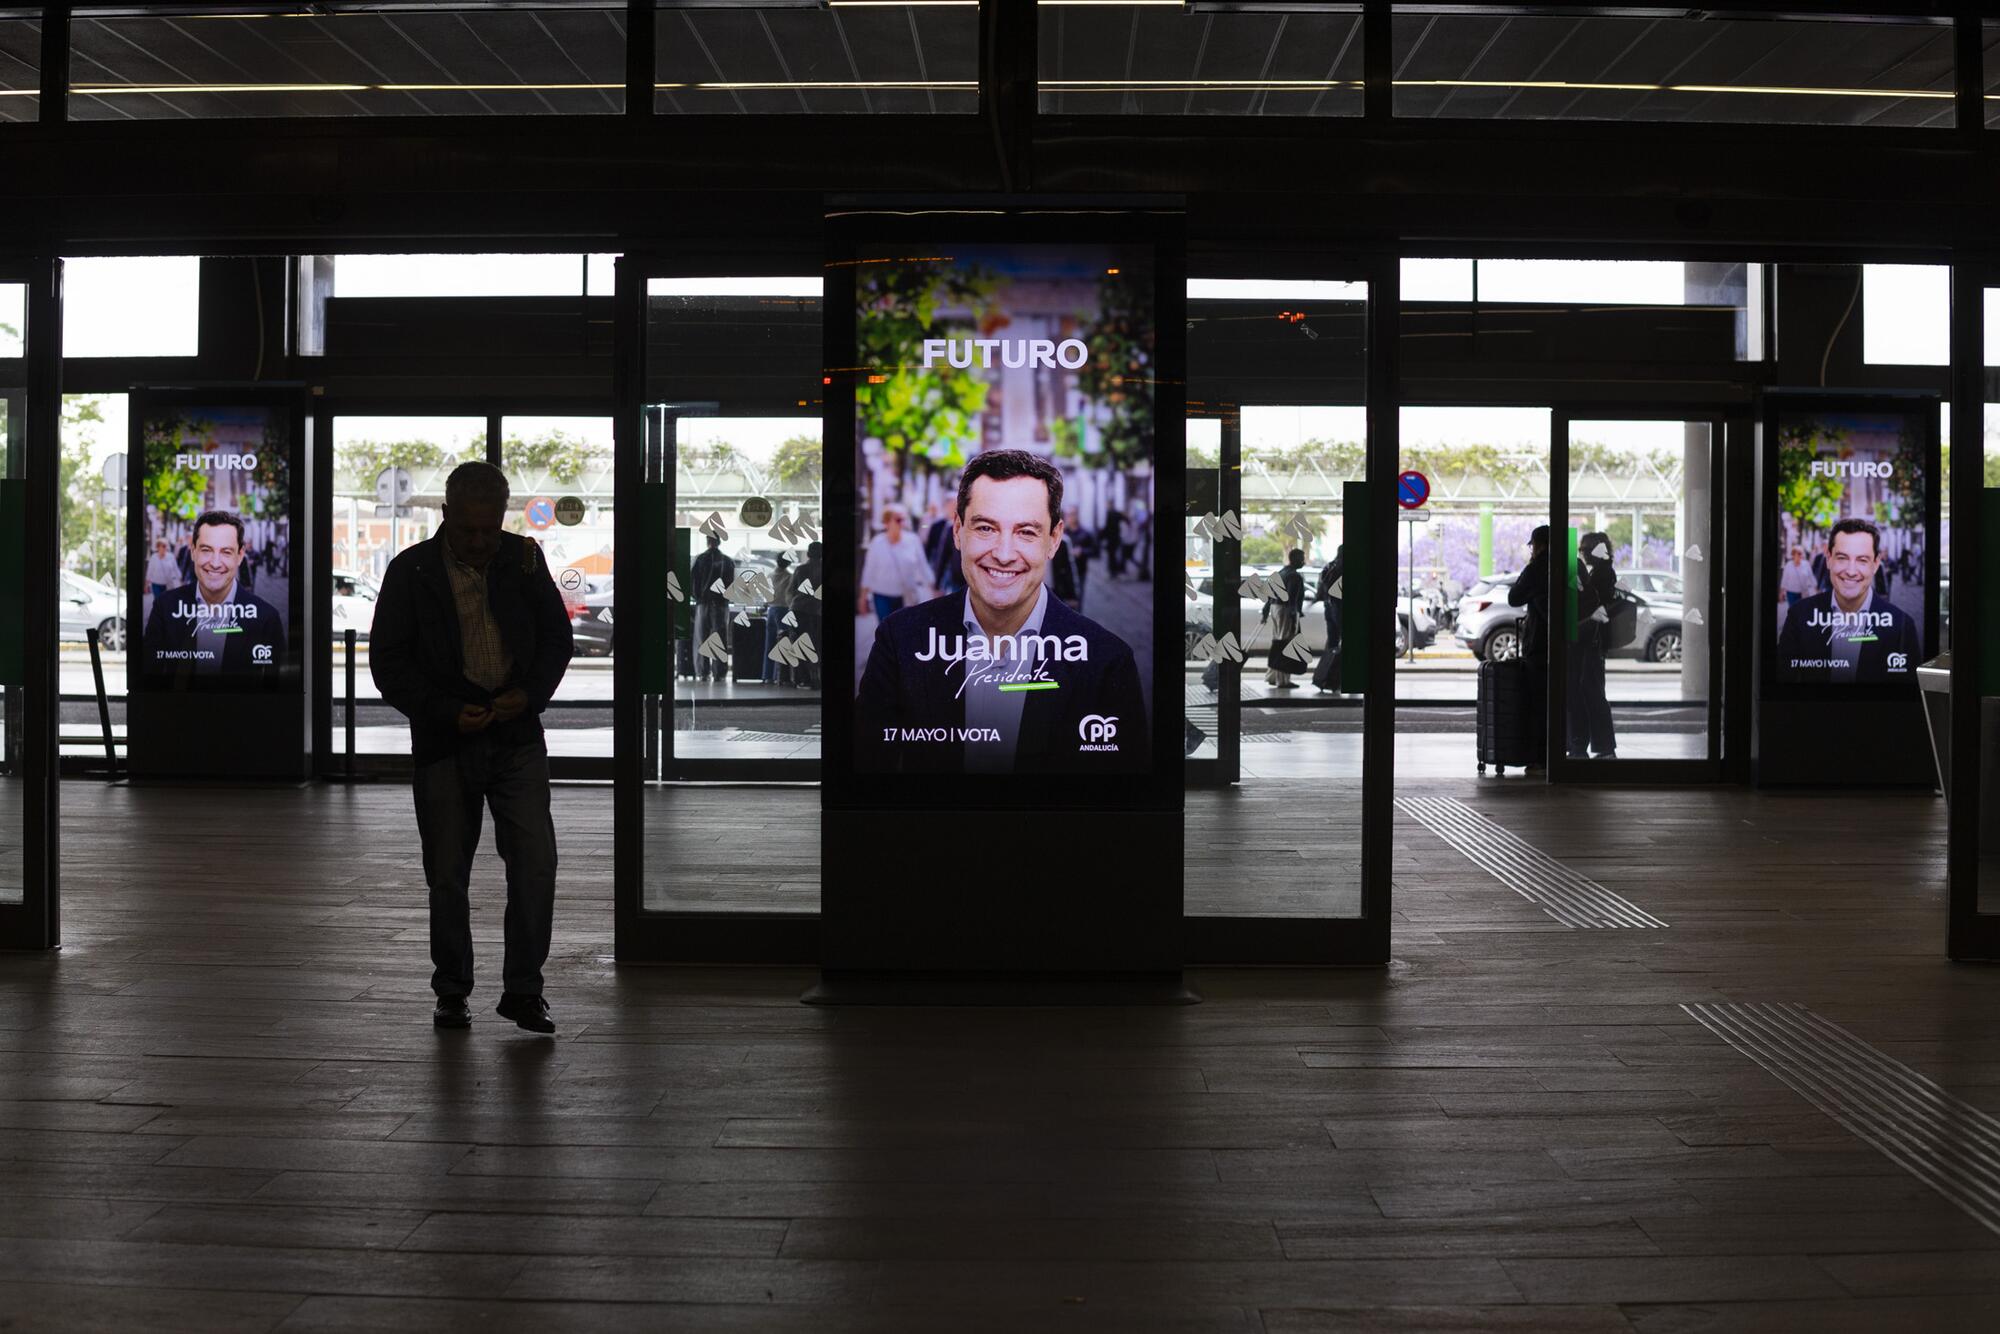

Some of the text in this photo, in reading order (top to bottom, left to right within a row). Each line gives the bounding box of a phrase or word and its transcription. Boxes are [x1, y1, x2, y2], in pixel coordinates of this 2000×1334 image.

[922, 339, 1088, 369] FUTURO
[175, 454, 258, 470] FUTURO
[1810, 461, 1894, 478] FUTURO
[171, 599, 258, 619] Juanma
[1806, 607, 1893, 627] Juanma
[914, 627, 1088, 662] Juanma
[156, 650, 215, 660] 17 MAYO VOTA
[1799, 659, 1824, 668] MAYO
[1828, 659, 1850, 668] VOTA
[944, 653, 1055, 699] Presidente
[883, 727, 1001, 742] 17 MAYO VOTA
[1079, 743, 1119, 751] ANDALUCÍA
